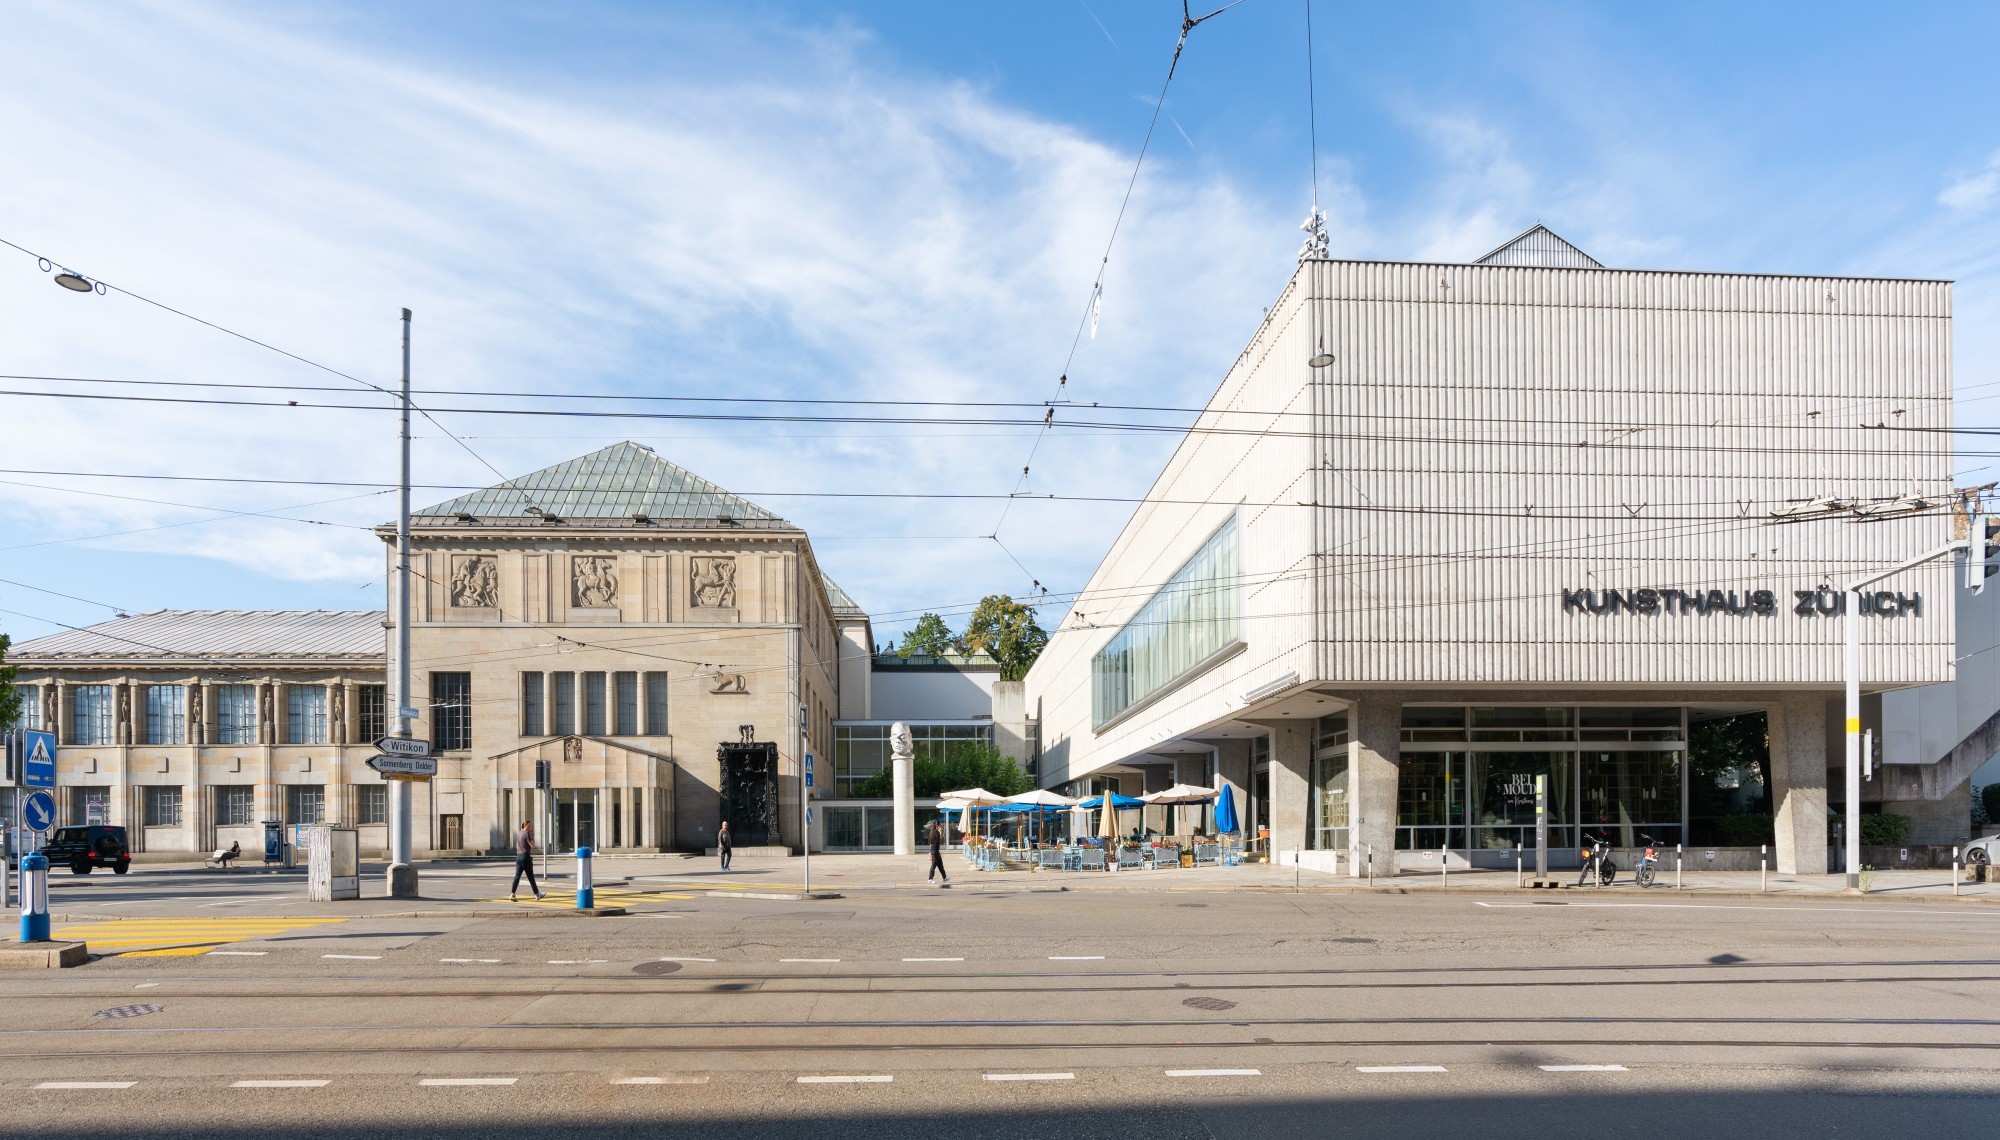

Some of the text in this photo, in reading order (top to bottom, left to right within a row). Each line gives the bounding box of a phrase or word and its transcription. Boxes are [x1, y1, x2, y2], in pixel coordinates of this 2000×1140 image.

[1562, 587, 1776, 614] KUNSTHAUS
[390, 741, 424, 753] Witikon
[379, 758, 433, 771] Sonnenberg Dolder
[1511, 773, 1532, 786] BEI
